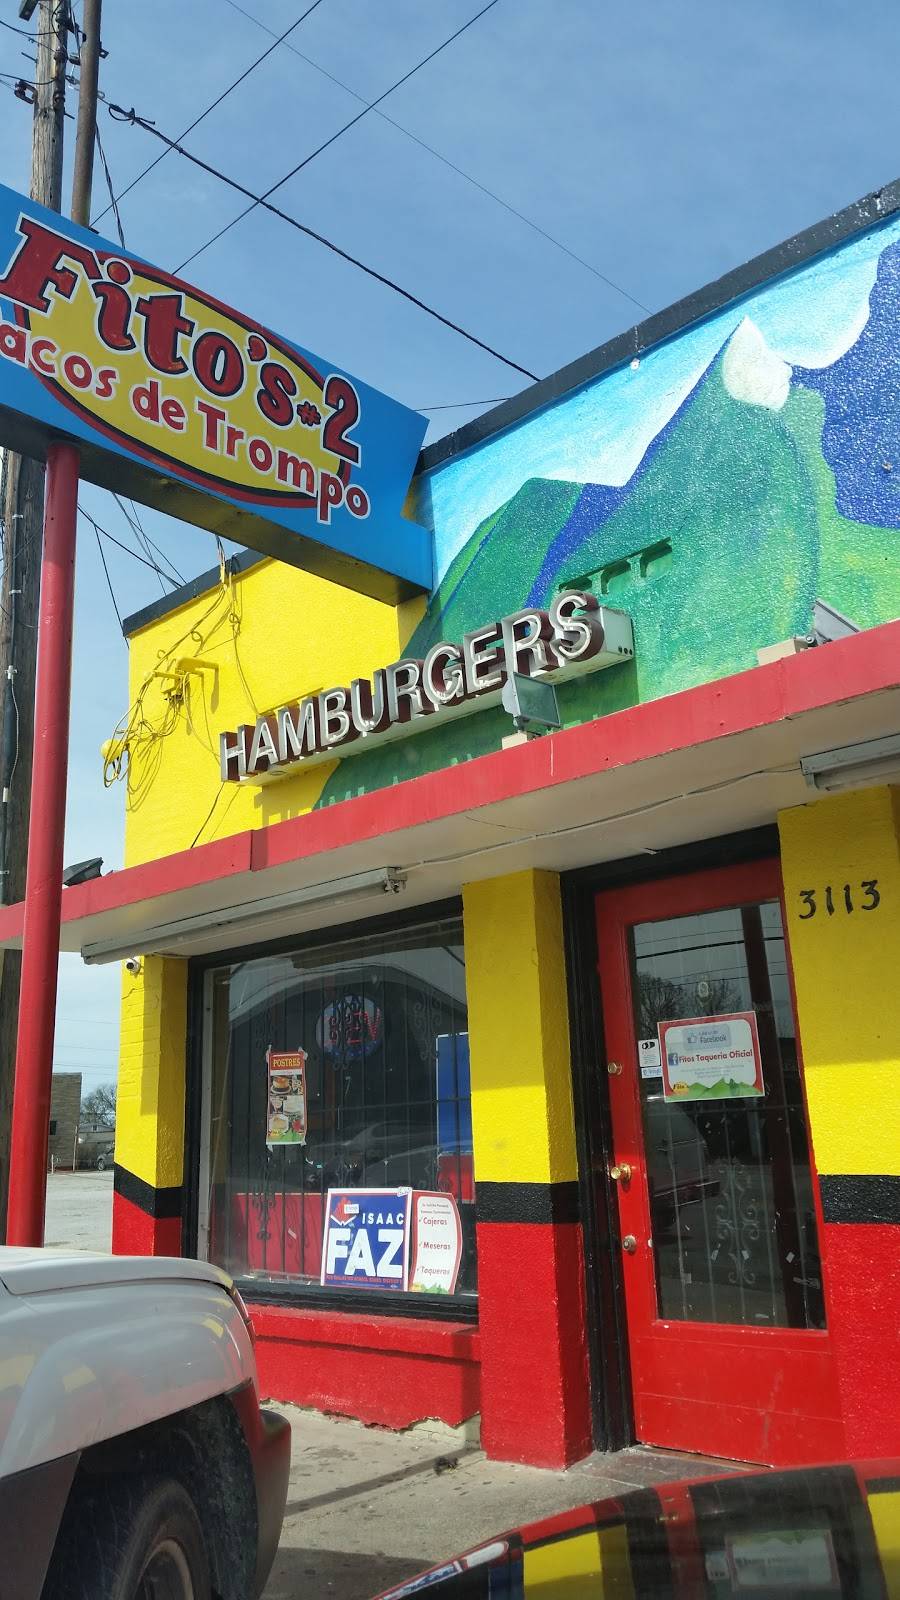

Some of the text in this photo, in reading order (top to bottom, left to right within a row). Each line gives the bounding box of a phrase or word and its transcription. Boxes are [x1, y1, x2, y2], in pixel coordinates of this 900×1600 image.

[0, 212, 298, 429] Fito's
[0, 320, 371, 525] acos de Trompo
[219, 589, 604, 783] HAMBURGERS
[798, 879, 881, 920] 3113
[272, 1058, 301, 1067] POSTRES
[729, 1049, 753, 1059] Oficial
[361, 1212, 404, 1225] ISAAC
[326, 1228, 404, 1279] FAZ
[423, 1241, 451, 1250] Meseras
